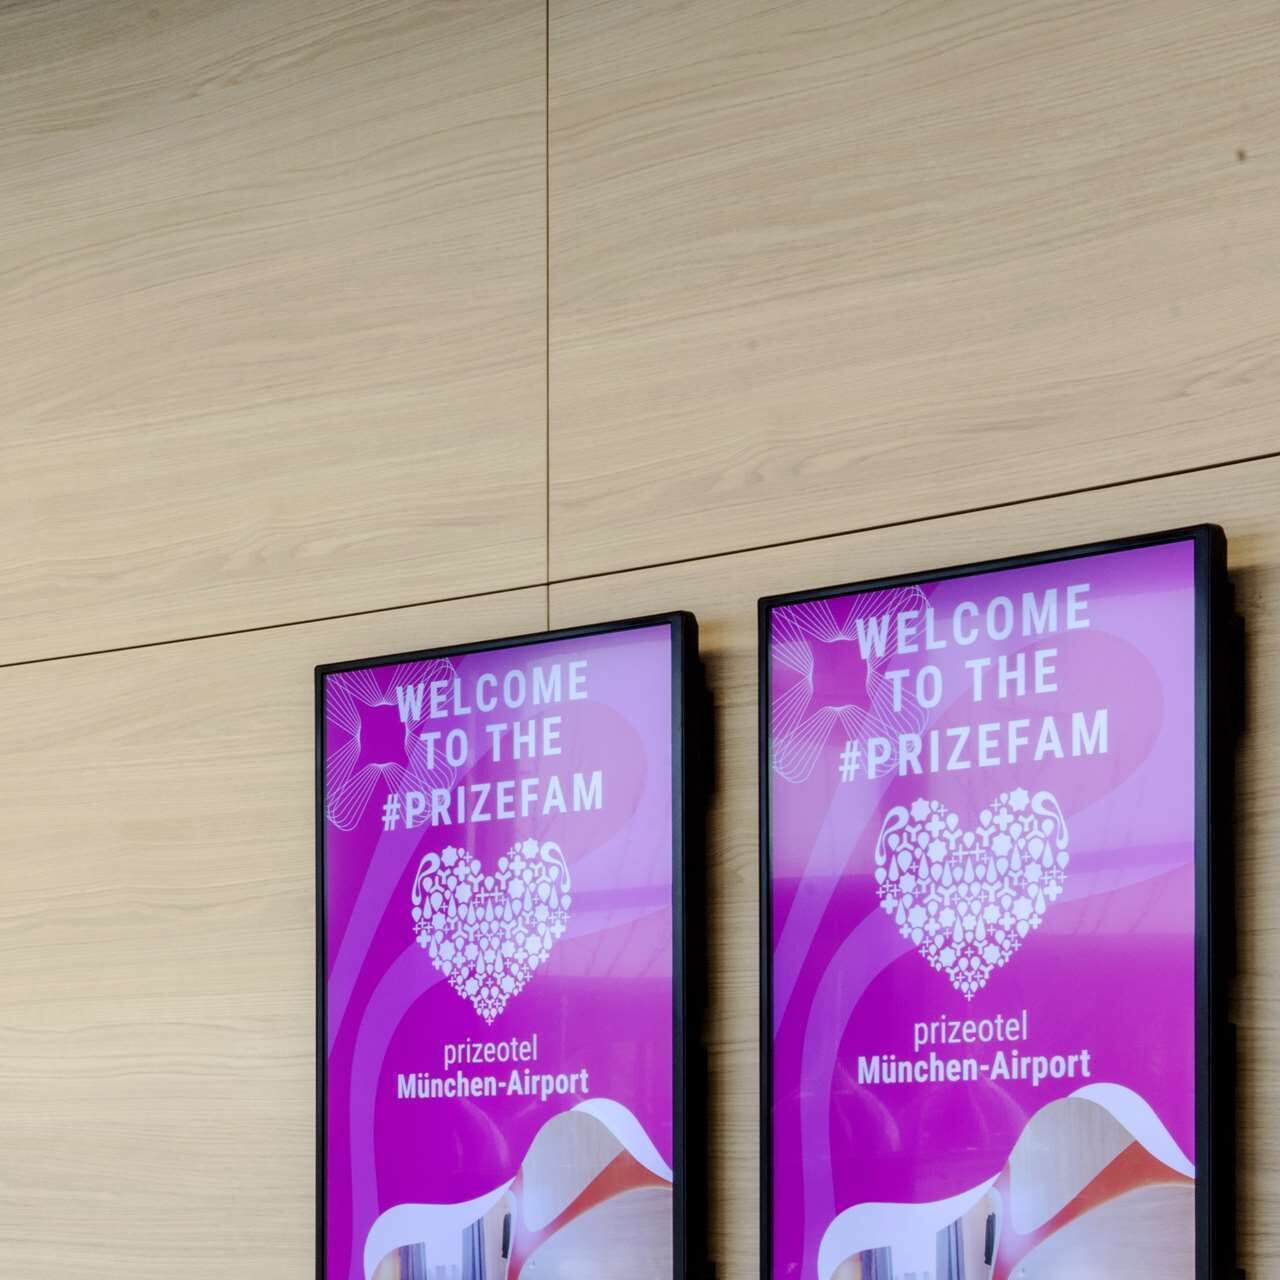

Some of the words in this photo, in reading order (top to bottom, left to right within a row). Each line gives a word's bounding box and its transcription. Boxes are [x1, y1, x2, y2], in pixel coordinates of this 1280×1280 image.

[855, 583, 1090, 660] WELCOME
[396, 660, 588, 723] WELCOME
[885, 665, 943, 712] TO
[965, 648, 1058, 701] THE
[420, 728, 468, 770] TO
[486, 715, 562, 762] THE
[838, 709, 1109, 783] #PRIZEFAM
[382, 770, 603, 831] #PRIZEFAM
[444, 1033, 538, 1070] prizeotel
[914, 1009, 1028, 1052] prizeotel
[397, 1068, 589, 1101] München-Airport
[857, 1049, 1091, 1087] München-Airport
